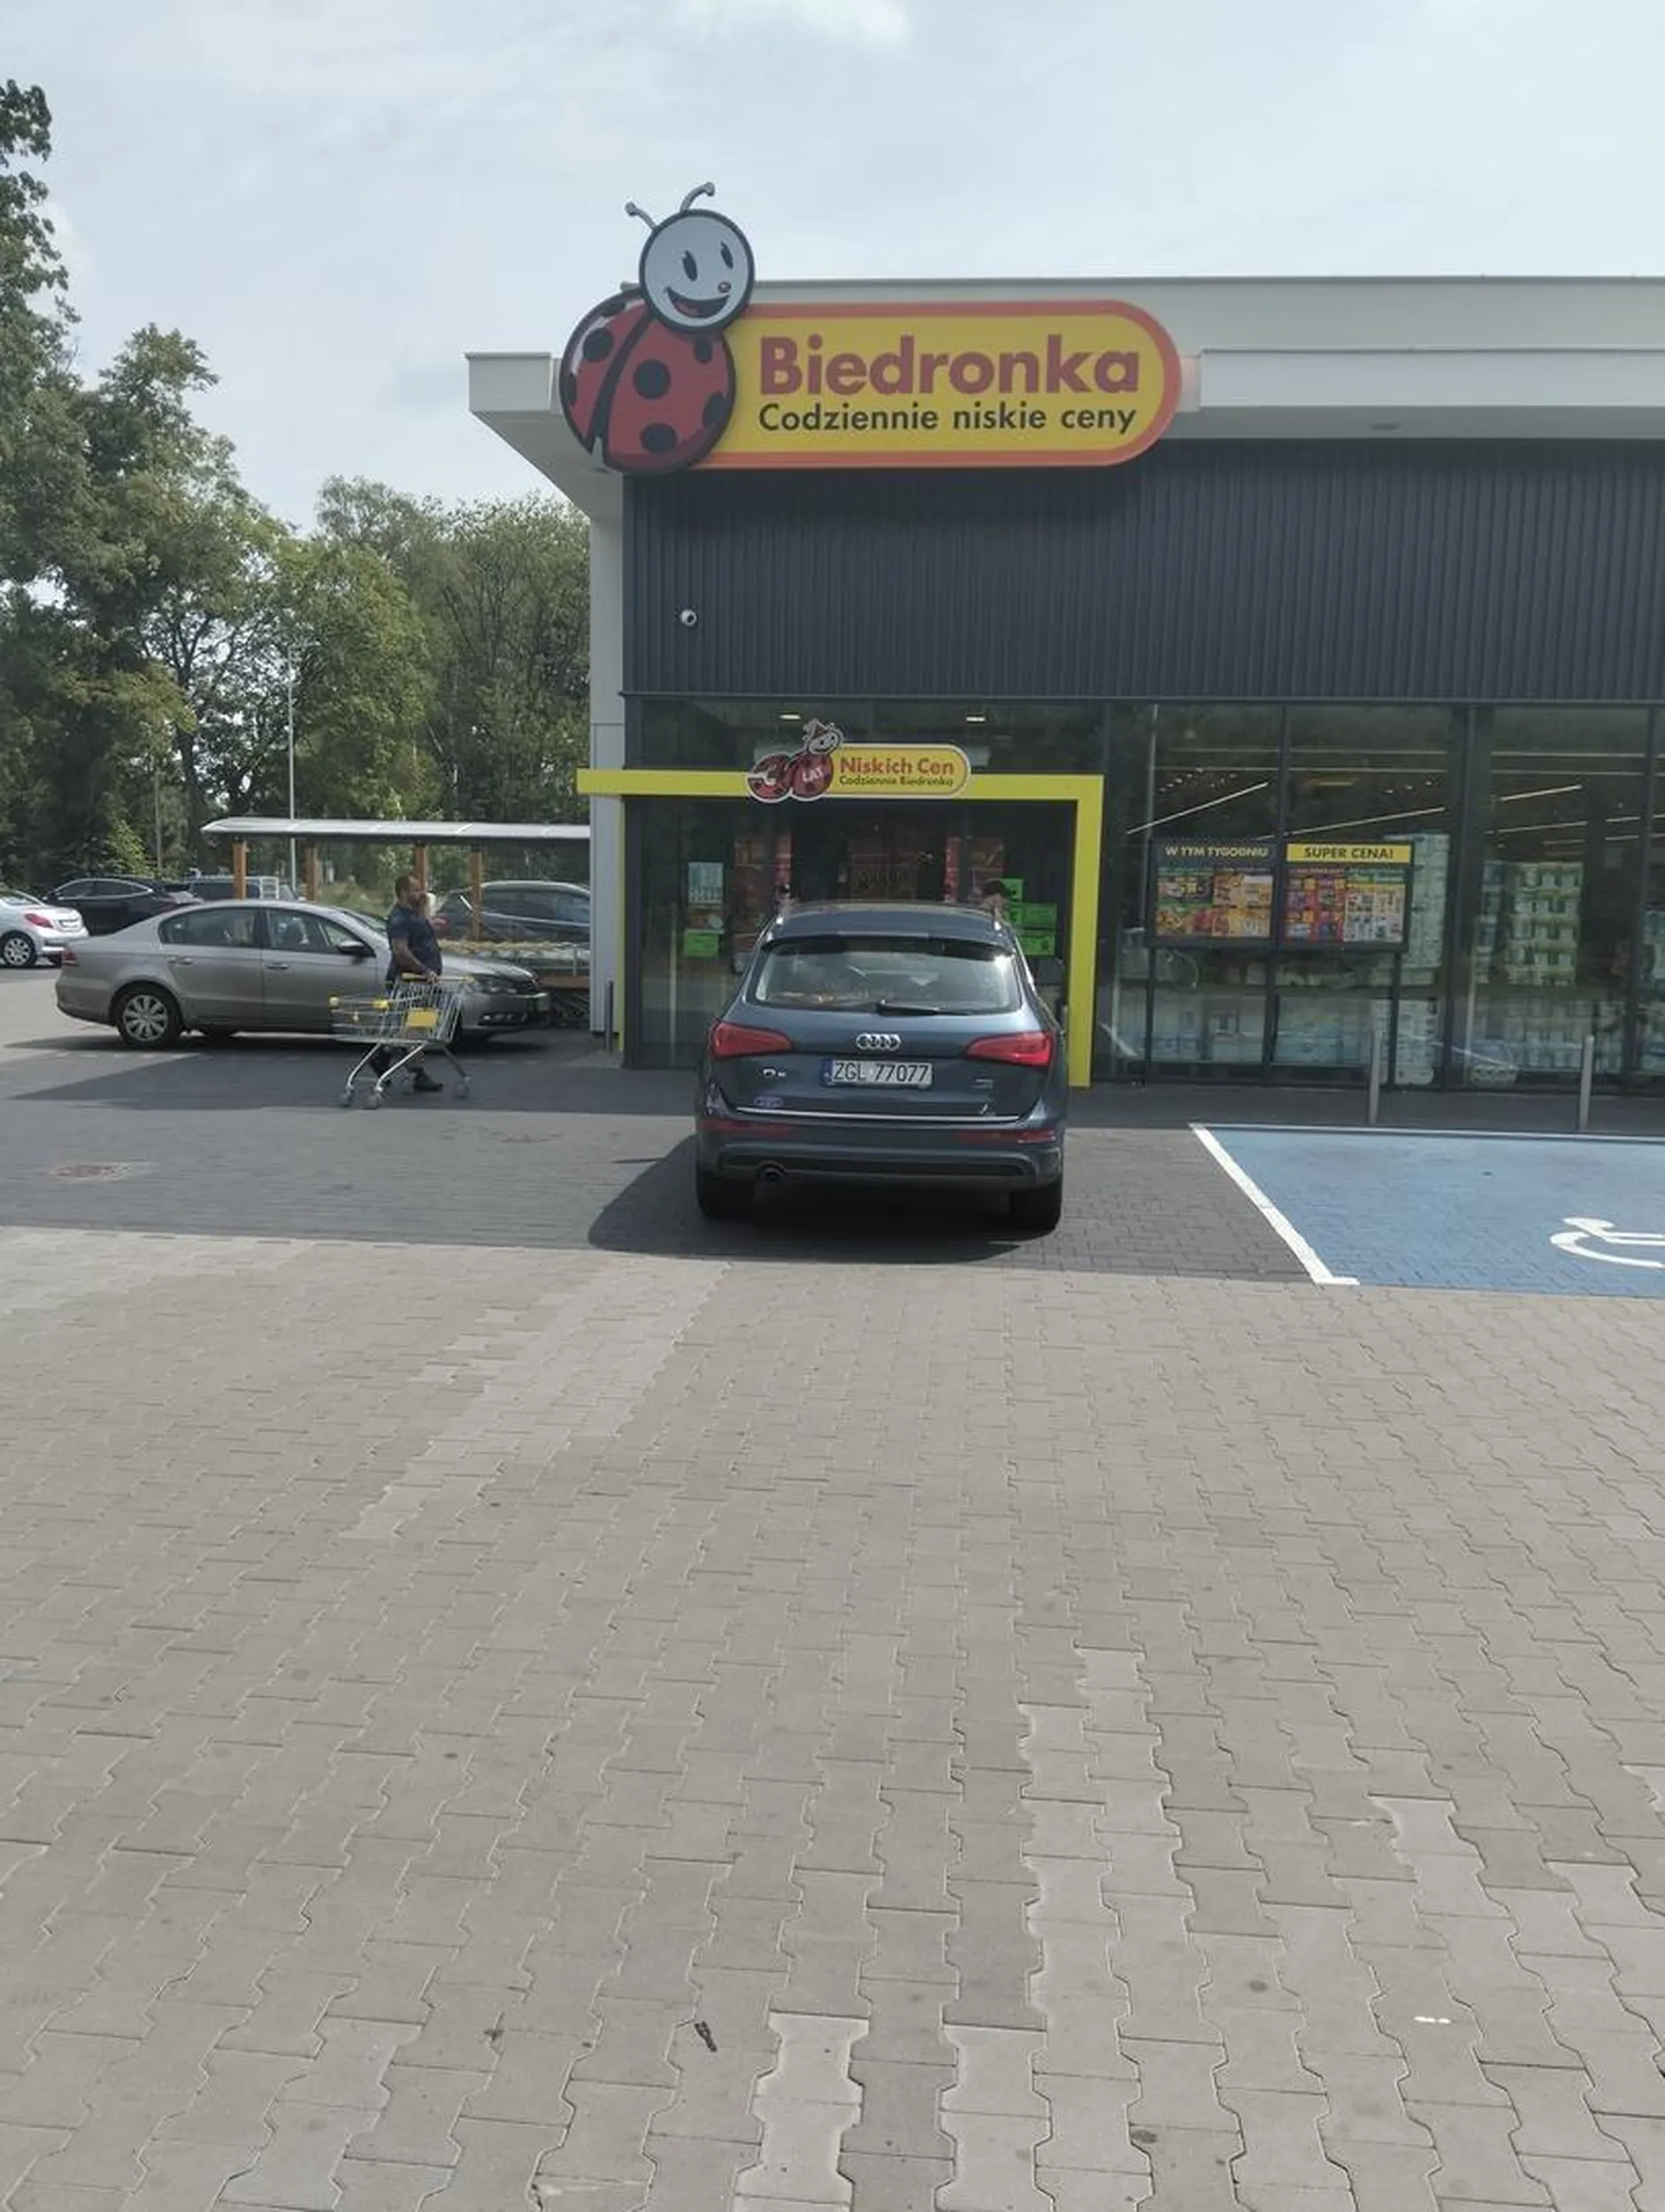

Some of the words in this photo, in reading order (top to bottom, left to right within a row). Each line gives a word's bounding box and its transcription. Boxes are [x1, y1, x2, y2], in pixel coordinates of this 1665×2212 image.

[760, 334, 1139, 395] Biedronka
[758, 402, 939, 432] Codziennie
[953, 401, 1046, 430] niskie
[1061, 408, 1137, 435] ceny
[840, 757, 912, 774] Niskich
[917, 758, 955, 775] Cen
[1165, 847, 1178, 856] W
[1180, 847, 1205, 857] TYM
[1208, 847, 1270, 858] TYGODNIU
[1304, 847, 1347, 859] SUPER
[1351, 848, 1394, 859] CENA!
[833, 1063, 866, 1081] ZGL
[875, 1064, 930, 1082] 77077
